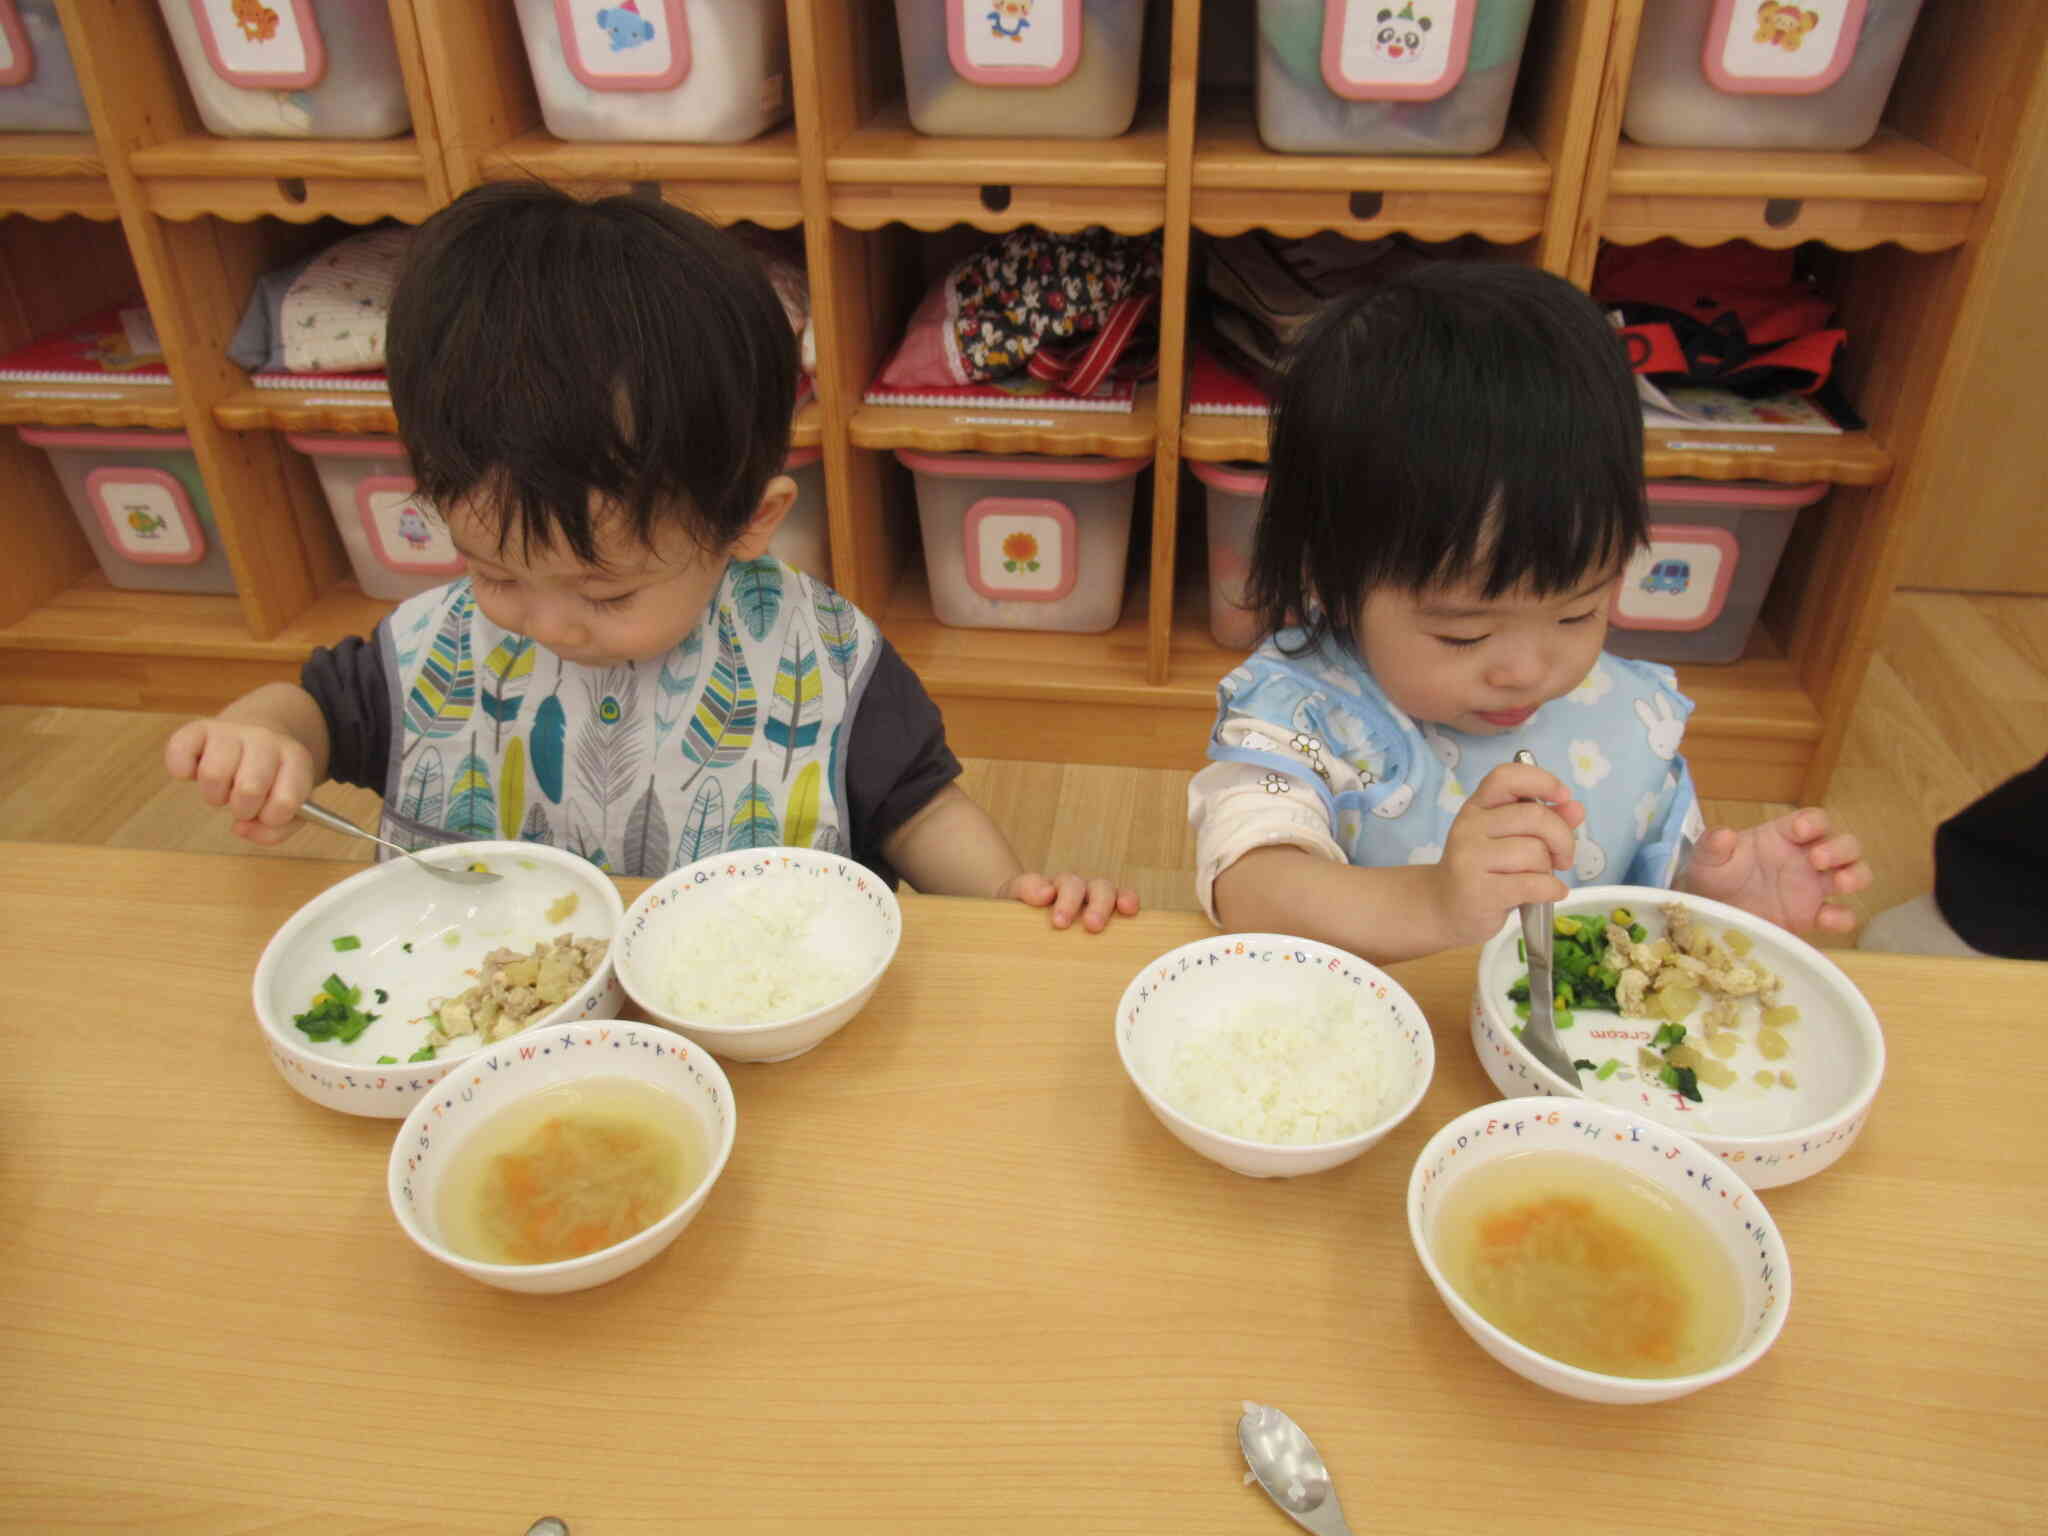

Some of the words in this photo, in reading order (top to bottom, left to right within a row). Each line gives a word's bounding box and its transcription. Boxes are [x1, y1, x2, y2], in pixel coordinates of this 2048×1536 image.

[694, 871, 710, 884] Q
[753, 863, 765, 876] S
[837, 862, 848, 877] V
[1234, 941, 1246, 956] B
[1261, 951, 1274, 963] C
[1293, 949, 1307, 964] D
[1327, 958, 1342, 974] E
[1588, 1029, 1652, 1040] cream
[485, 1055, 499, 1071] V
[519, 1045, 538, 1061] W
[559, 1032, 577, 1050] X
[1485, 1118, 1499, 1137] E
[1513, 1119, 1526, 1137] F
[1546, 1111, 1563, 1127] G
[1583, 1122, 1602, 1140] H
[1629, 1126, 1642, 1142] I
[1664, 1145, 1682, 1160] J
[1701, 1172, 1714, 1192] K
